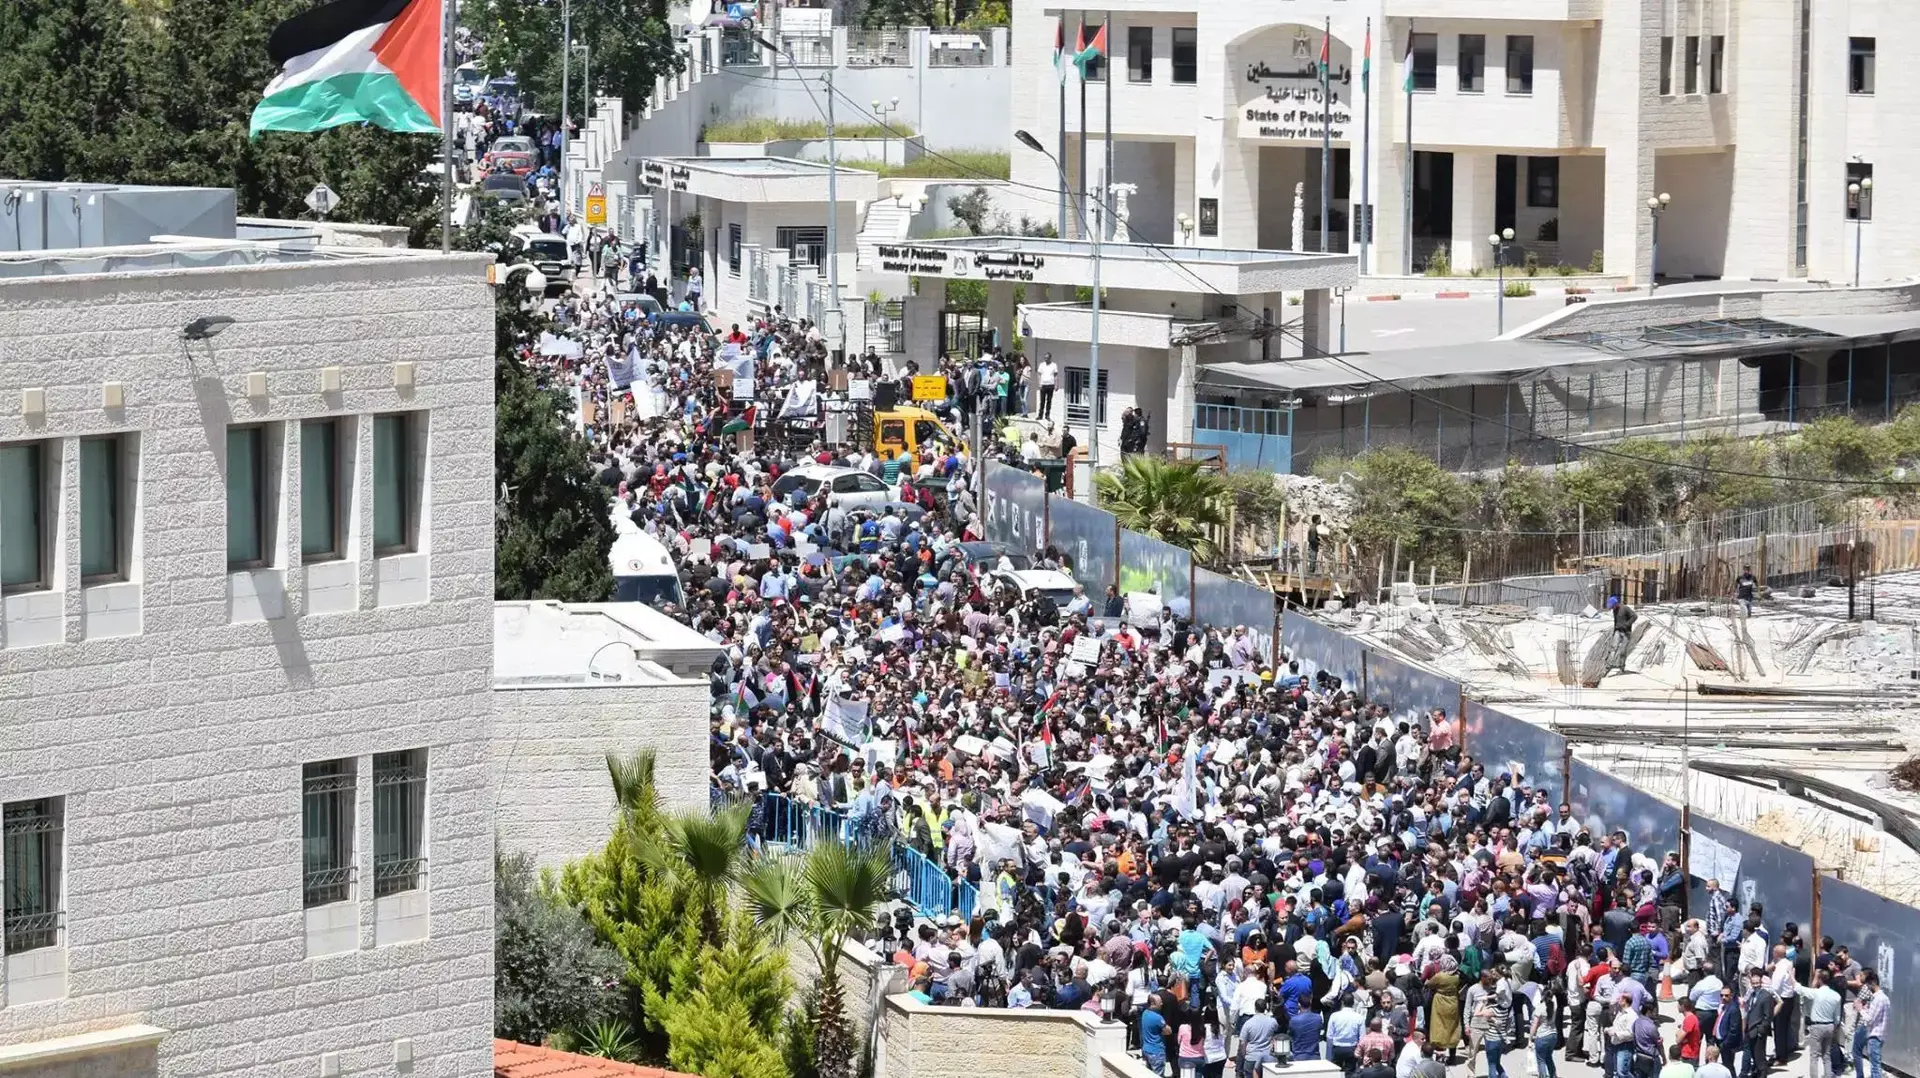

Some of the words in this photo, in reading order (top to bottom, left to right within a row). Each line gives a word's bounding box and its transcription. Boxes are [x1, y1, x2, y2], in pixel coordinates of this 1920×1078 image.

[1247, 61, 1318, 83] فلسطين
[1246, 109, 1279, 121] State
[1284, 110, 1296, 122] of
[1259, 126, 1296, 139] Ministry
[1297, 128, 1308, 137] of
[911, 248, 947, 261] Palestine
